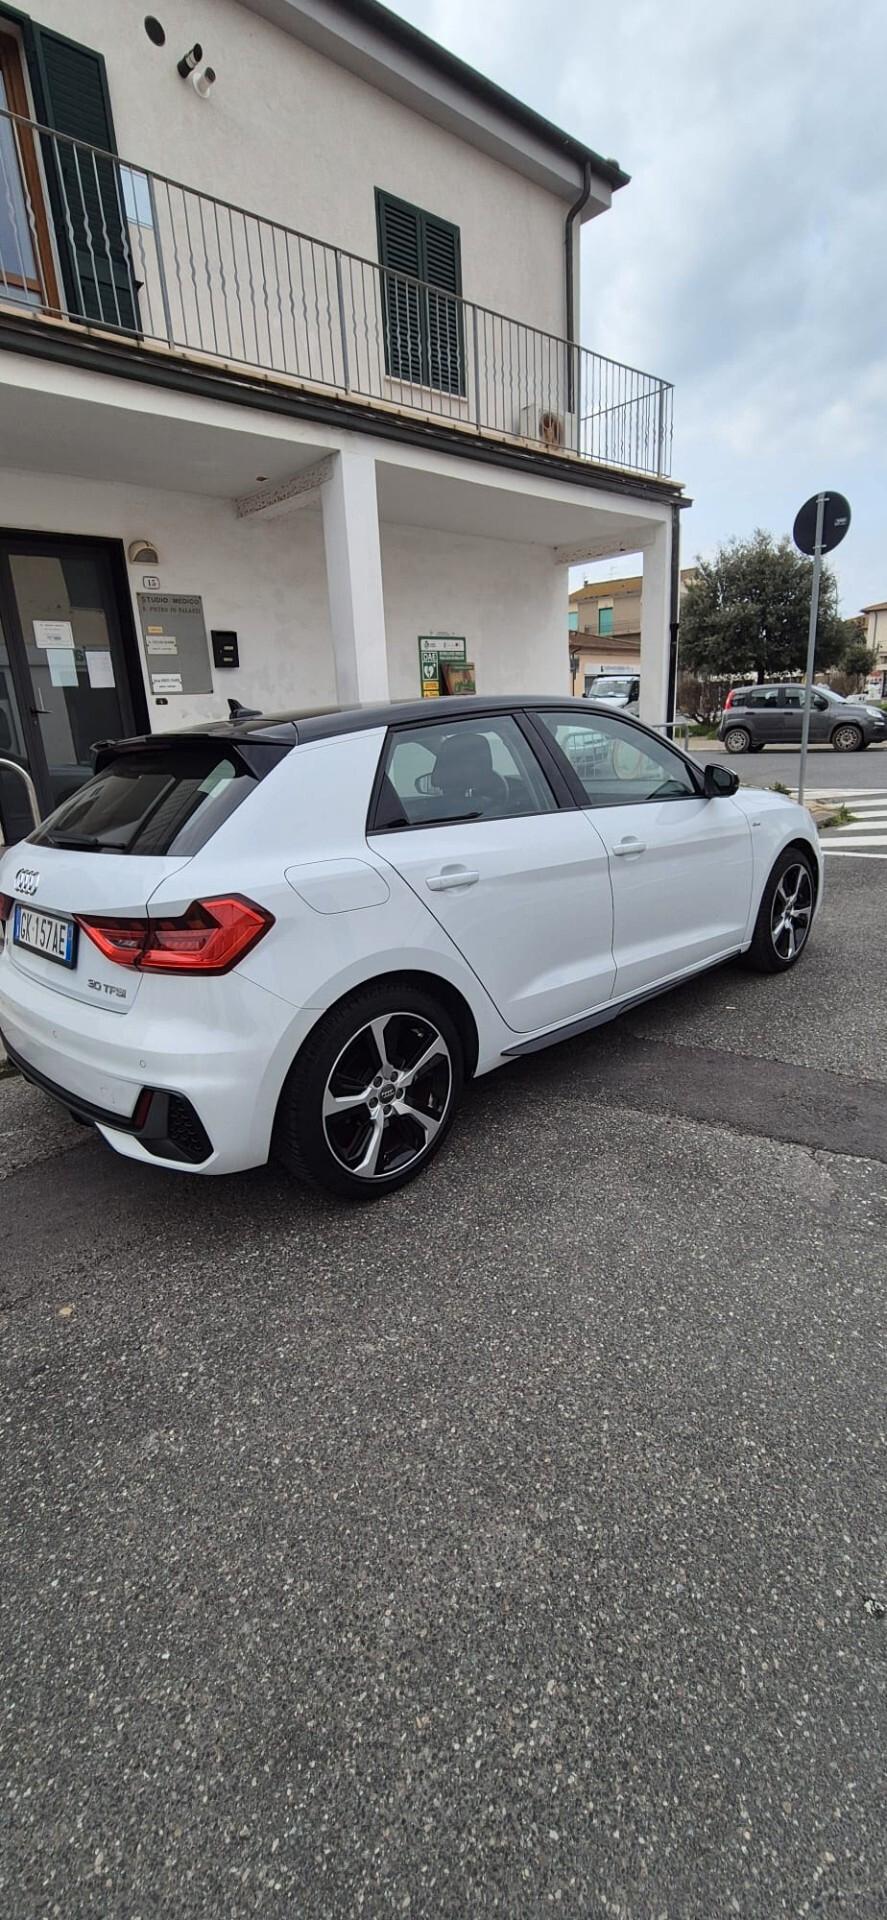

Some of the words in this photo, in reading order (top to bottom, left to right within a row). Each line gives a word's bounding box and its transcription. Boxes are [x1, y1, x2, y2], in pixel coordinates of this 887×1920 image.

[141, 596, 169, 604] STUDIO
[87, 979, 102, 991] 30
[103, 983, 127, 999] TFSI
